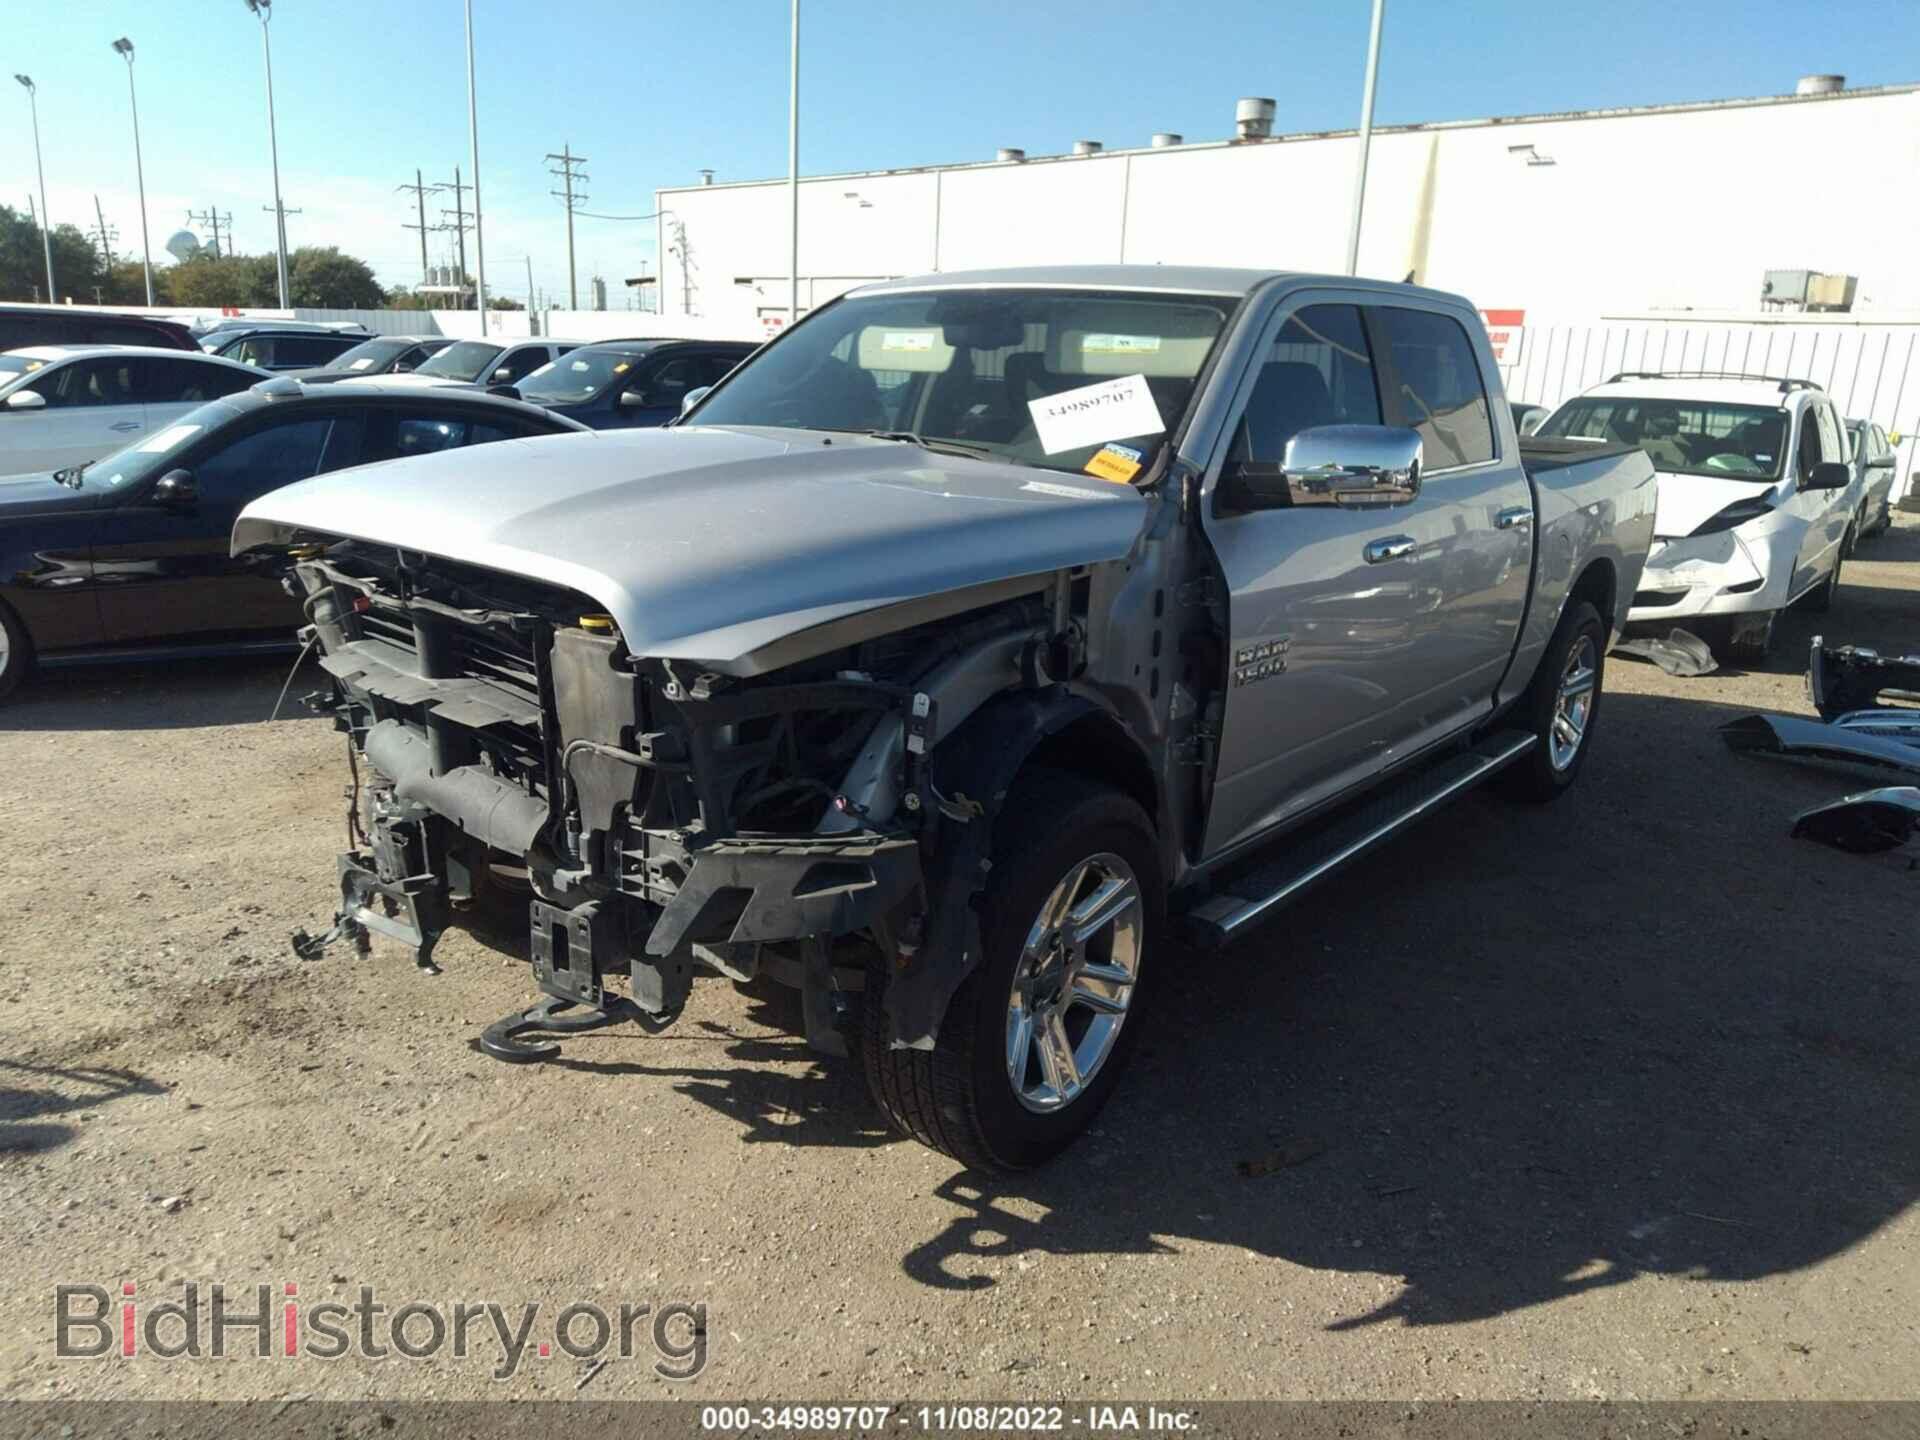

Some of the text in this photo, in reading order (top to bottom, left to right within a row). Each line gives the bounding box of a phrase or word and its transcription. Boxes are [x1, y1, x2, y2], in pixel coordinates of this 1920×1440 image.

[1047, 389, 1134, 415] 34989707
[1235, 637, 1289, 667] RAM
[1232, 658, 1288, 688] 1500
